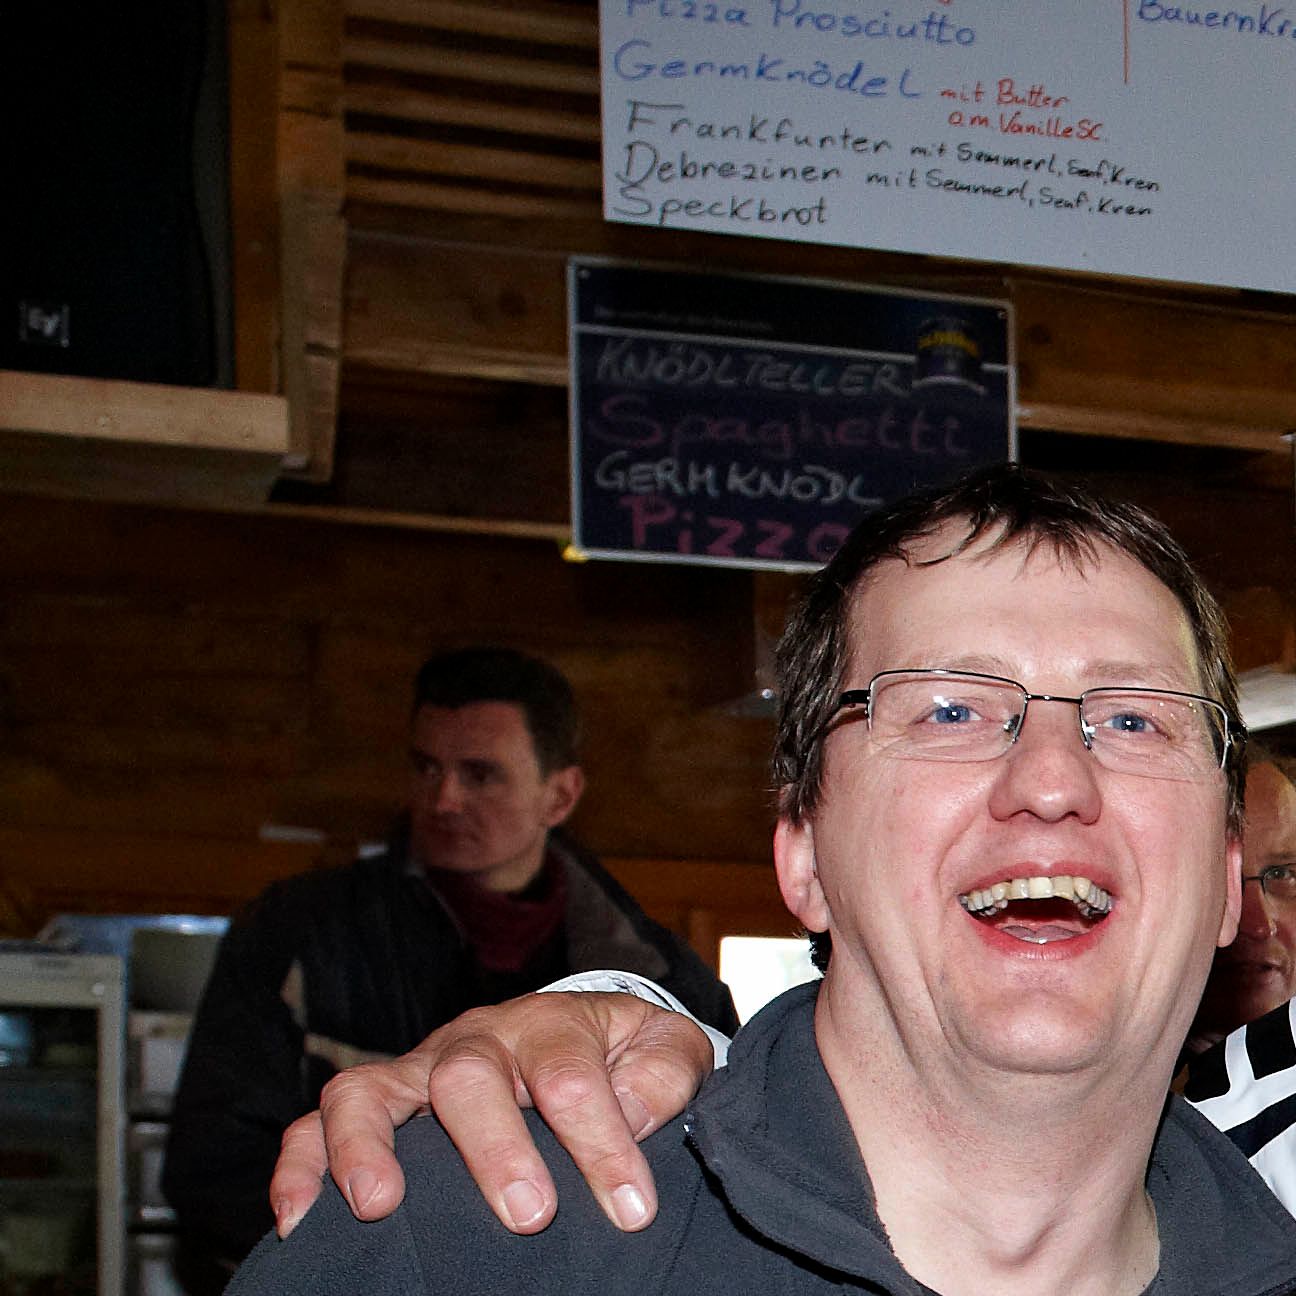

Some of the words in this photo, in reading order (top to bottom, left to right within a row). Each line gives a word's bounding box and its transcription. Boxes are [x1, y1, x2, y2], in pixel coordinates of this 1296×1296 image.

[771, 0, 976, 45] Prosciutto
[939, 80, 984, 103] mit
[997, 78, 1070, 107] Butter
[911, 144, 947, 155] mit
[866, 170, 917, 187] mit
[592, 394, 971, 461] Spaghetti
